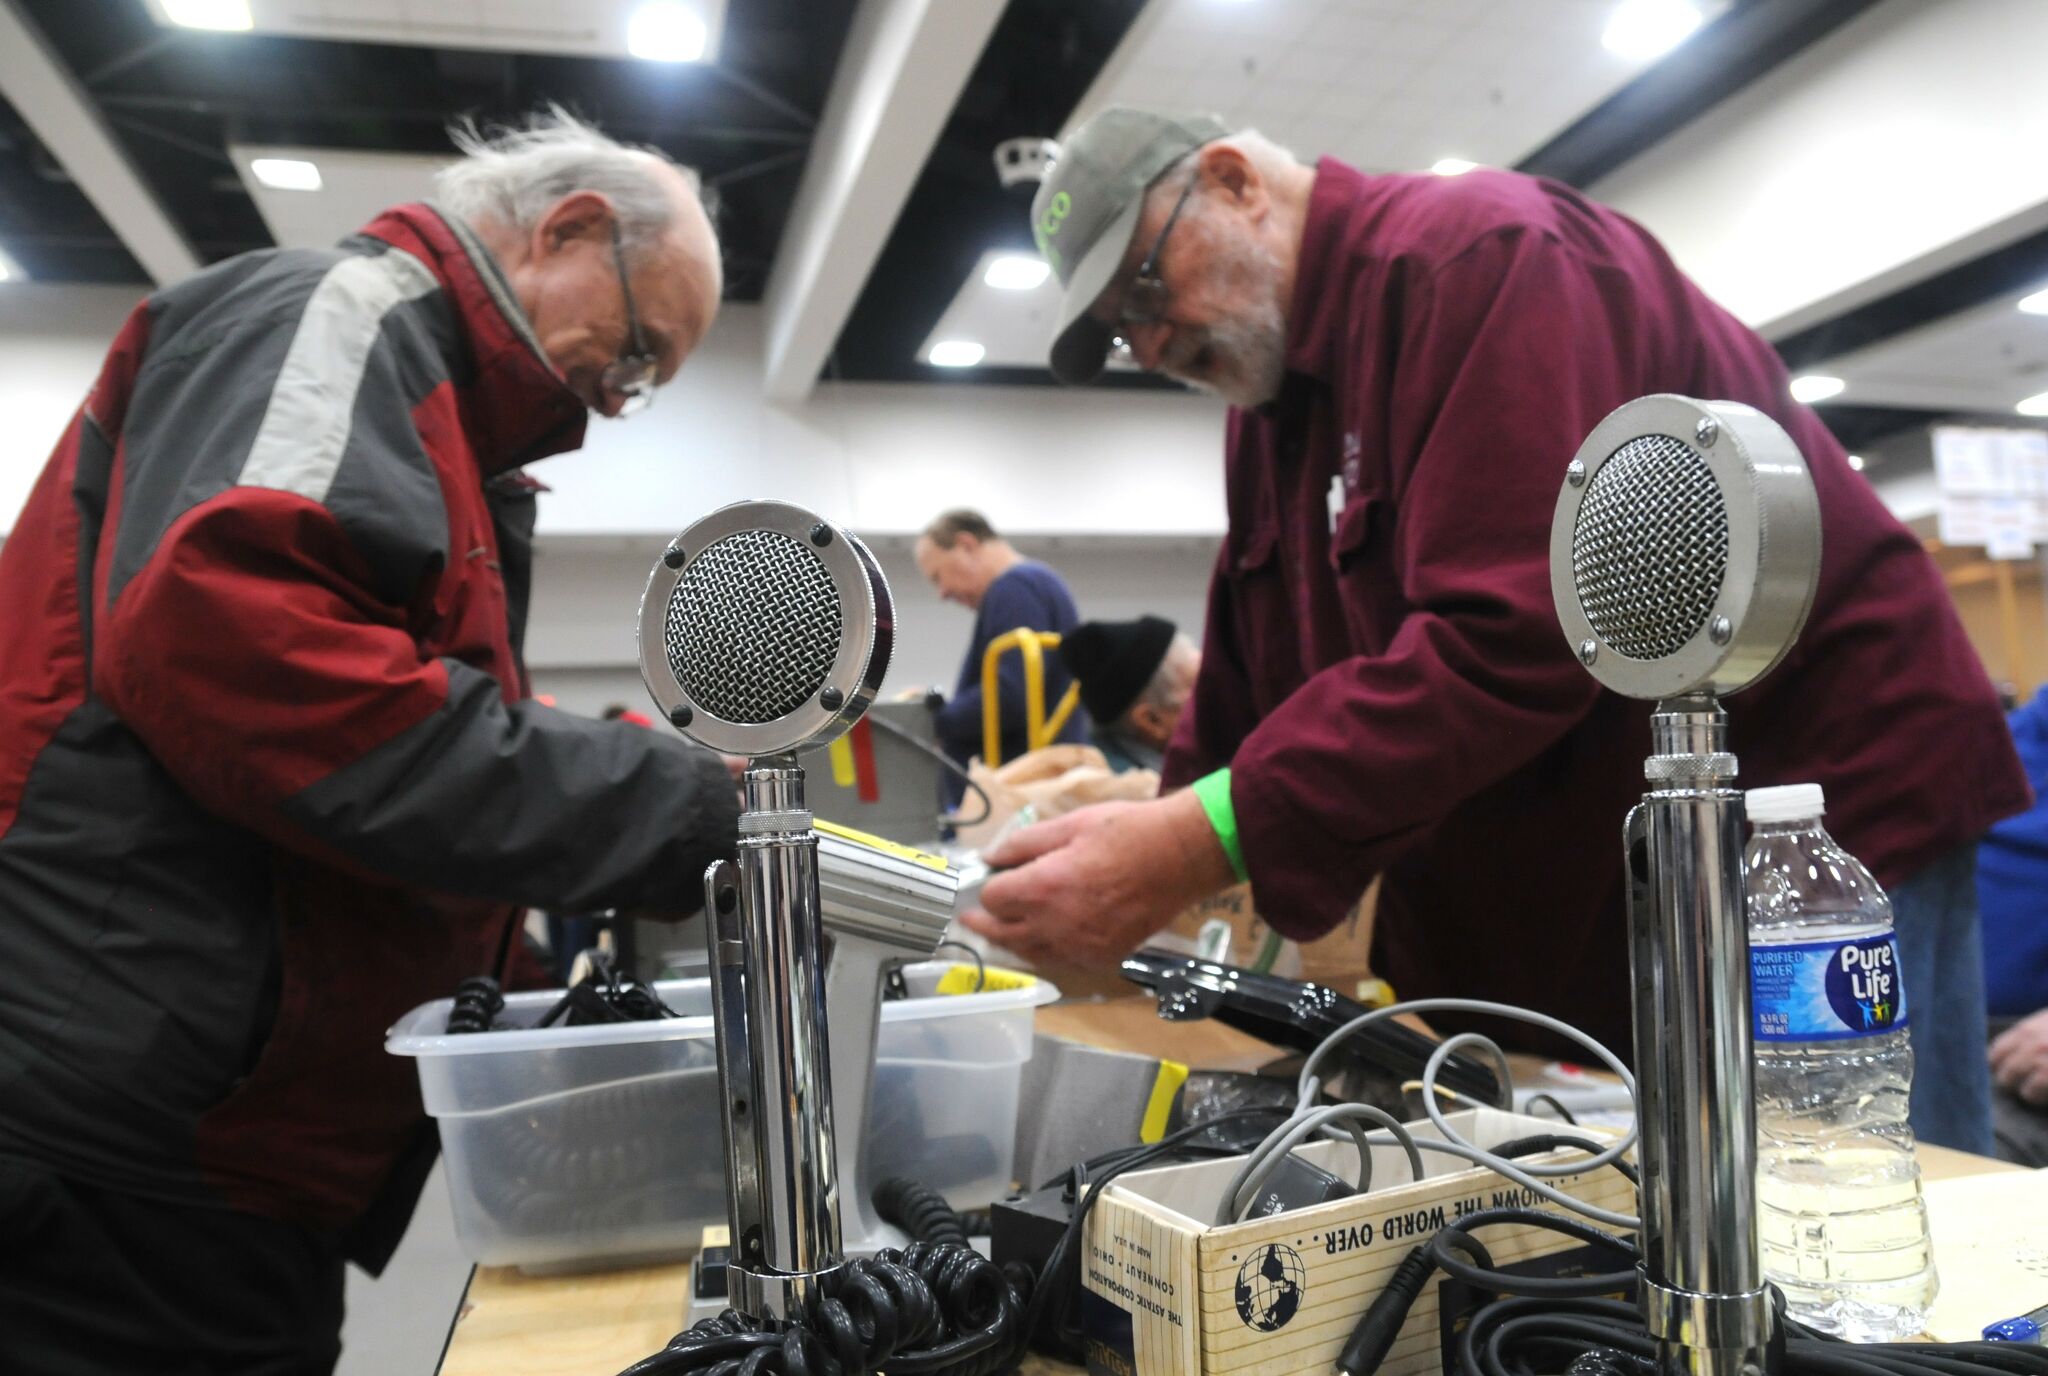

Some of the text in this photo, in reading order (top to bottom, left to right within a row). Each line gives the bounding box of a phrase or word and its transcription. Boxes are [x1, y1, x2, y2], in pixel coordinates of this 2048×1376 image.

[1752, 950, 1803, 964] PURIFIED
[1754, 964, 1794, 977] WATER
[1841, 944, 1892, 973] Pure
[1852, 969, 1891, 1004] Life
[1383, 1206, 1446, 1241] WORLD
[1137, 1244, 1152, 1261] MADE
[1325, 1224, 1373, 1255] OVER
[1093, 1246, 1175, 1297] CONNEAUT OHIO
[1089, 1268, 1183, 1327] THE ASTATIC CORPORATION
